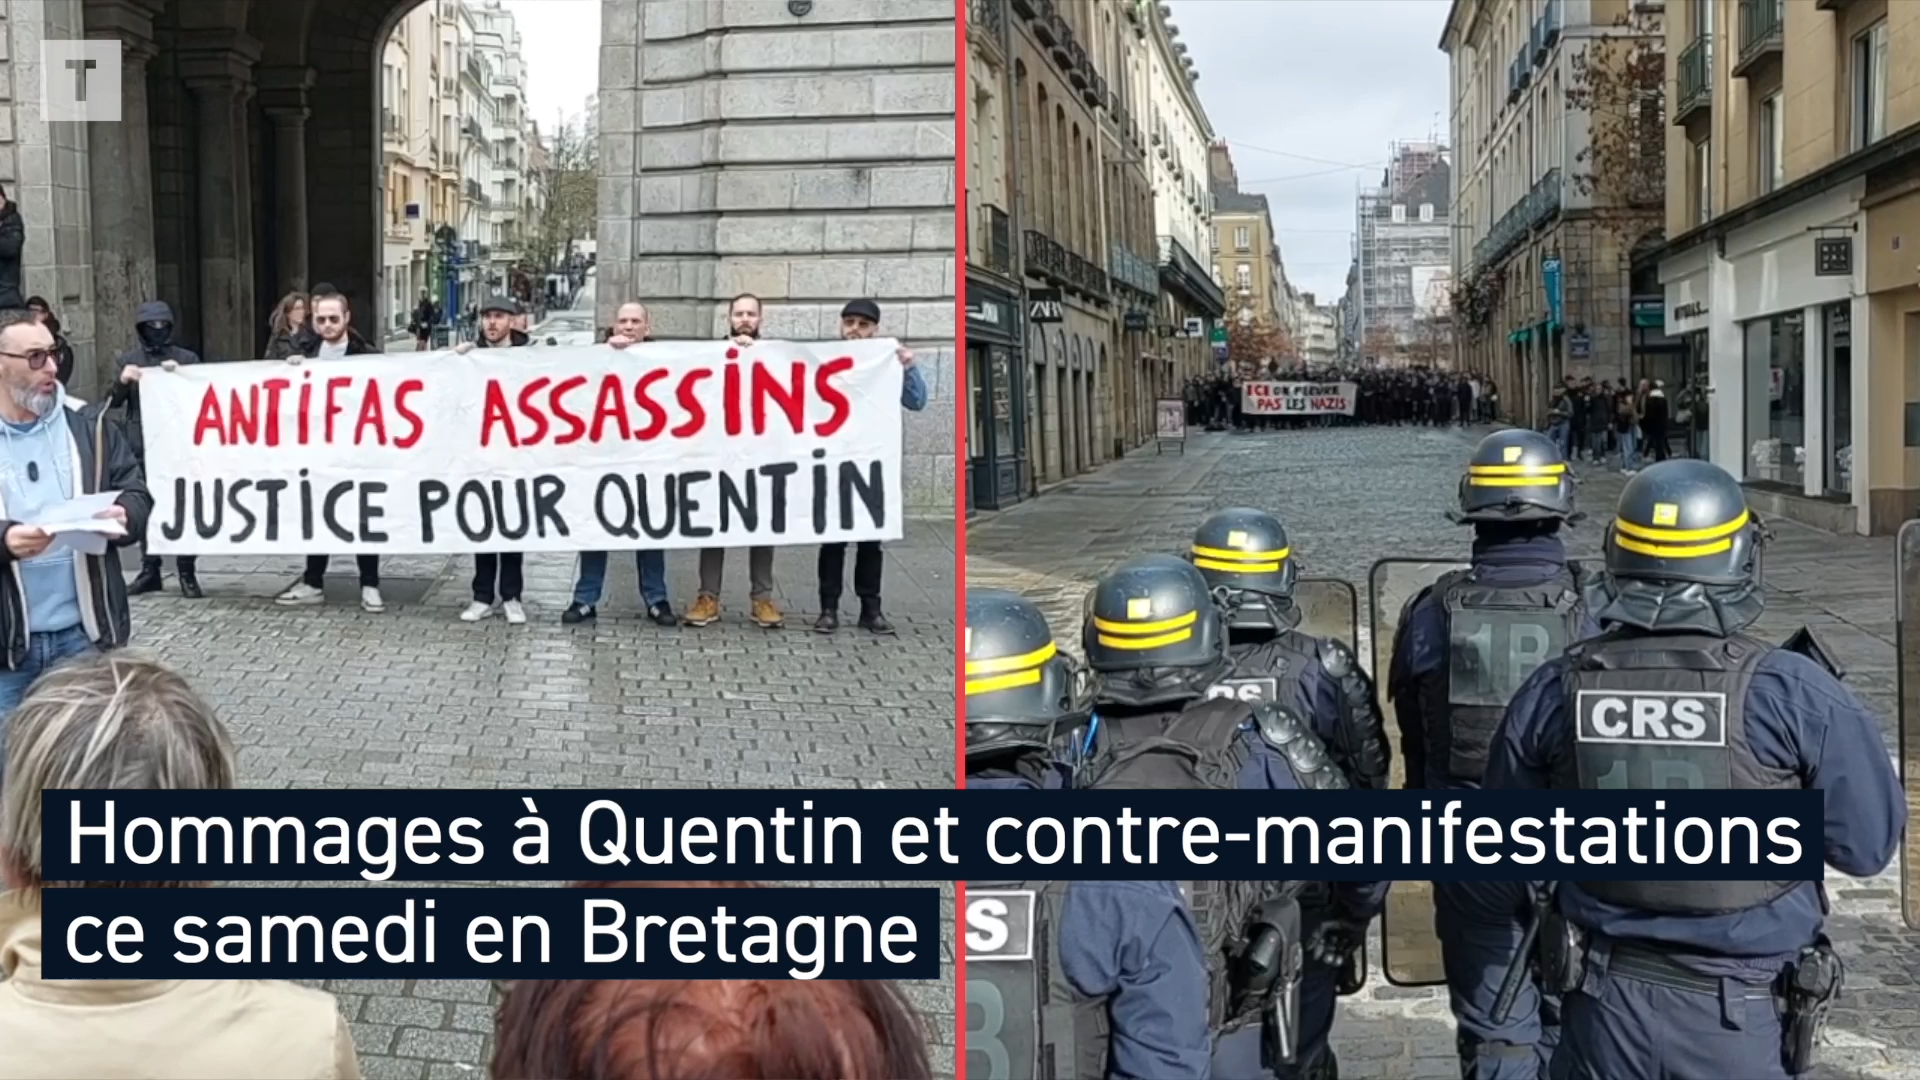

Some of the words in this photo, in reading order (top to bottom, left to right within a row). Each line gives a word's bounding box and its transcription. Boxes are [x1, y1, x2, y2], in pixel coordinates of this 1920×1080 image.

[1246, 385, 1270, 397] ICI
[1258, 399, 1281, 410] PAS
[1286, 399, 1306, 411] LES
[1311, 398, 1345, 410] NAZIS
[419, 475, 570, 543] POUR
[1591, 697, 1707, 740] CRS
